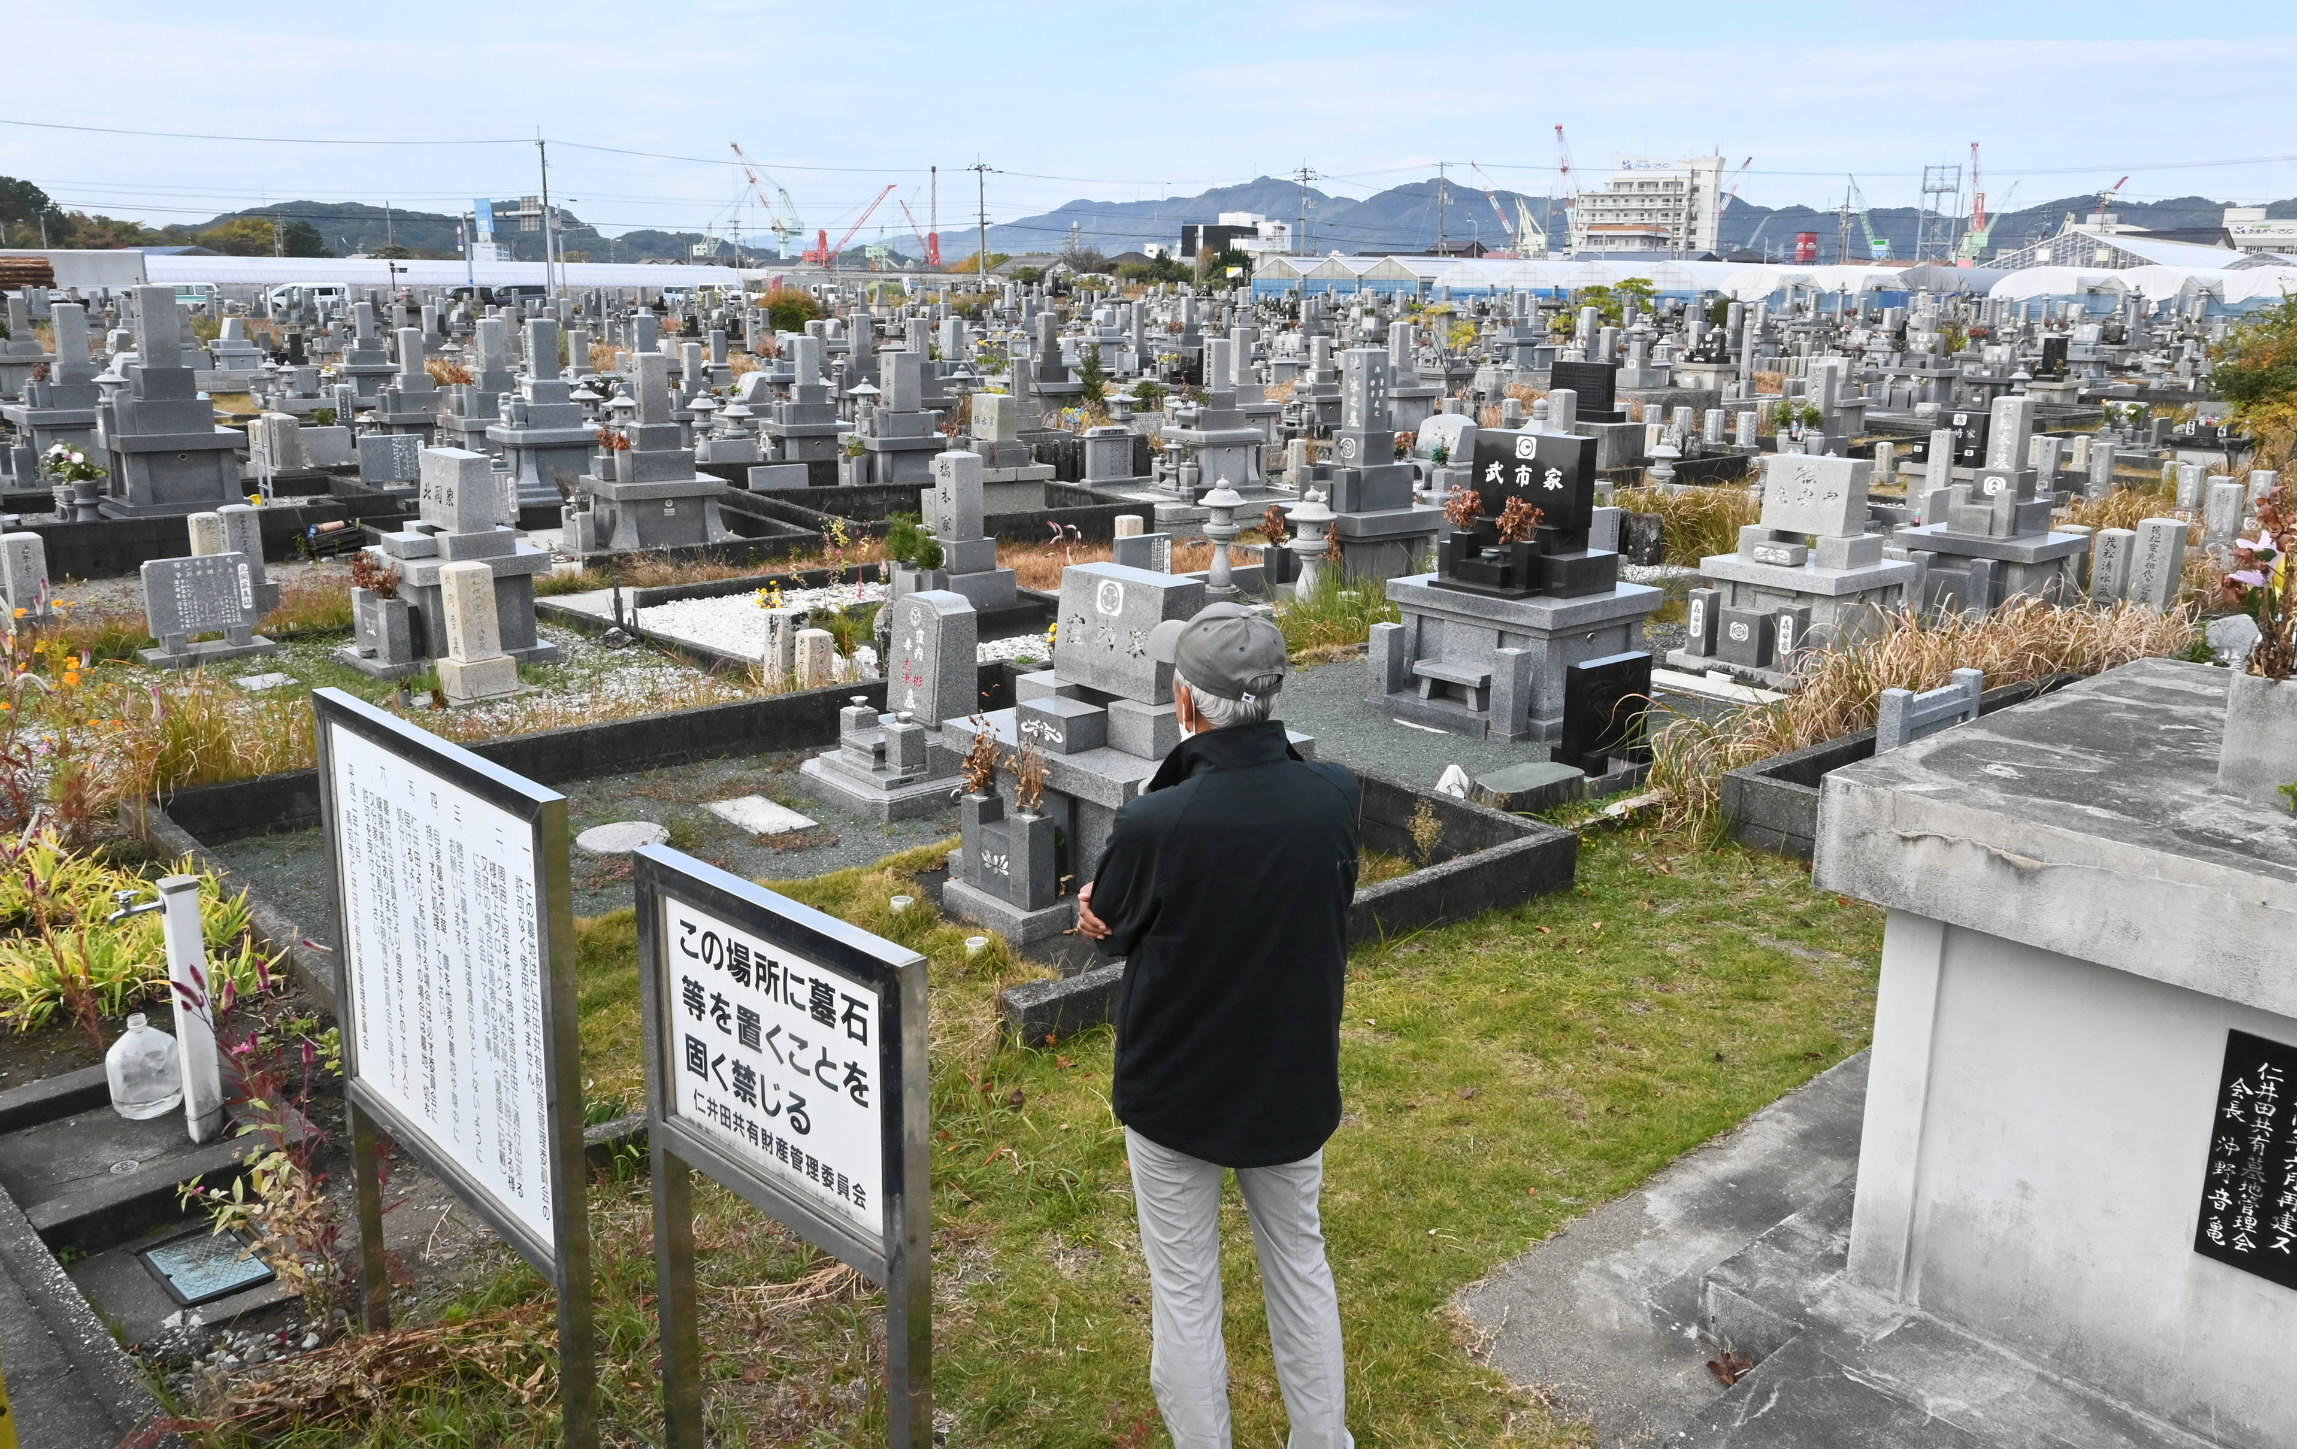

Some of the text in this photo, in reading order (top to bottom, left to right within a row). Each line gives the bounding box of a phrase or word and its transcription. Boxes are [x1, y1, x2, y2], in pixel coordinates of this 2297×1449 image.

[1485, 460, 1563, 491] 武市家
[679, 919, 869, 1048] この場所に墓石
[682, 975, 869, 1109] 等を置くことを
[685, 1033, 811, 1136] 固く禁じる
[693, 1088, 867, 1212] 仁井田共有財産管理委員会
[2232, 1062, 2285, 1253] 仁井田共有墓地管理会
